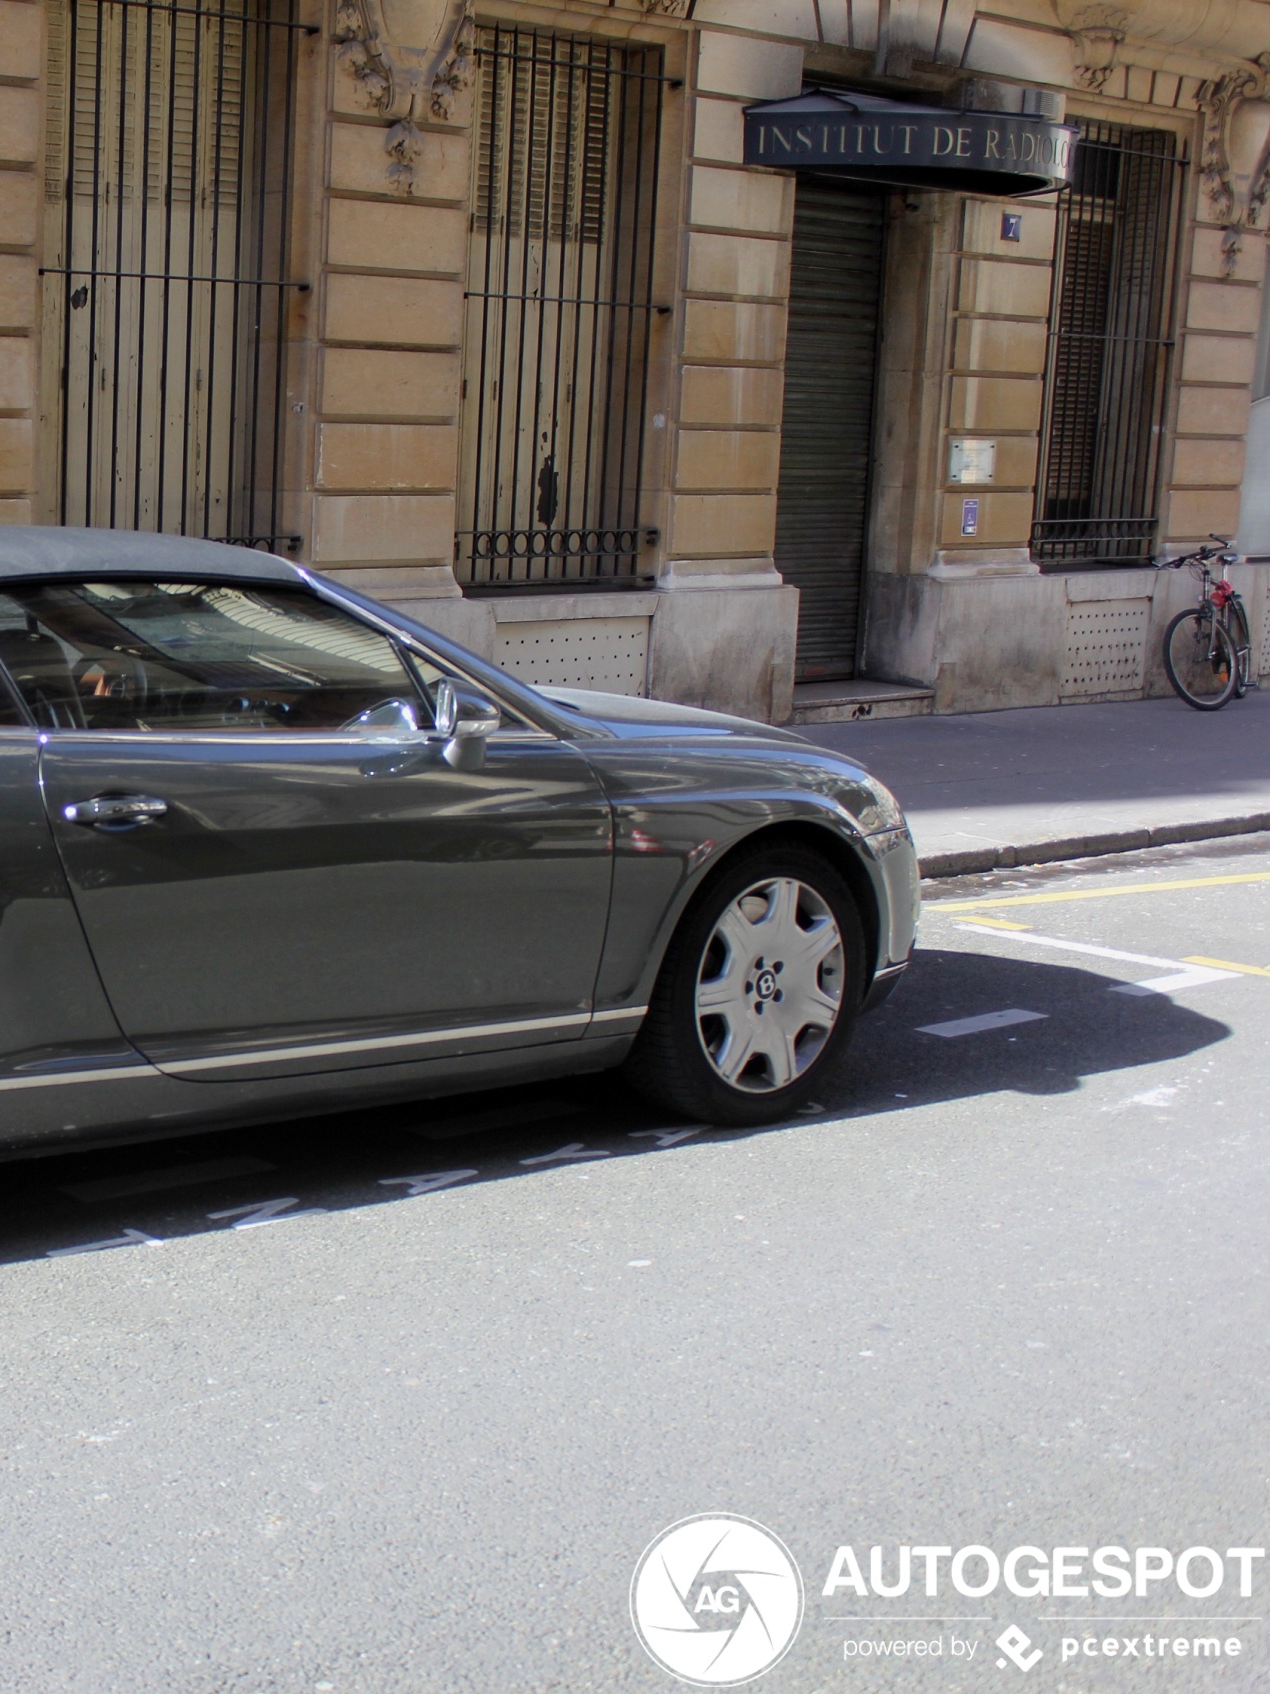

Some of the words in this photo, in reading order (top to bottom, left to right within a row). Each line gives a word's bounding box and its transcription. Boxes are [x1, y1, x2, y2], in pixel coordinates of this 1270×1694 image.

[757, 124, 918, 155] INSTITUT
[932, 127, 971, 157] DE
[1008, 217, 1018, 237] 7
